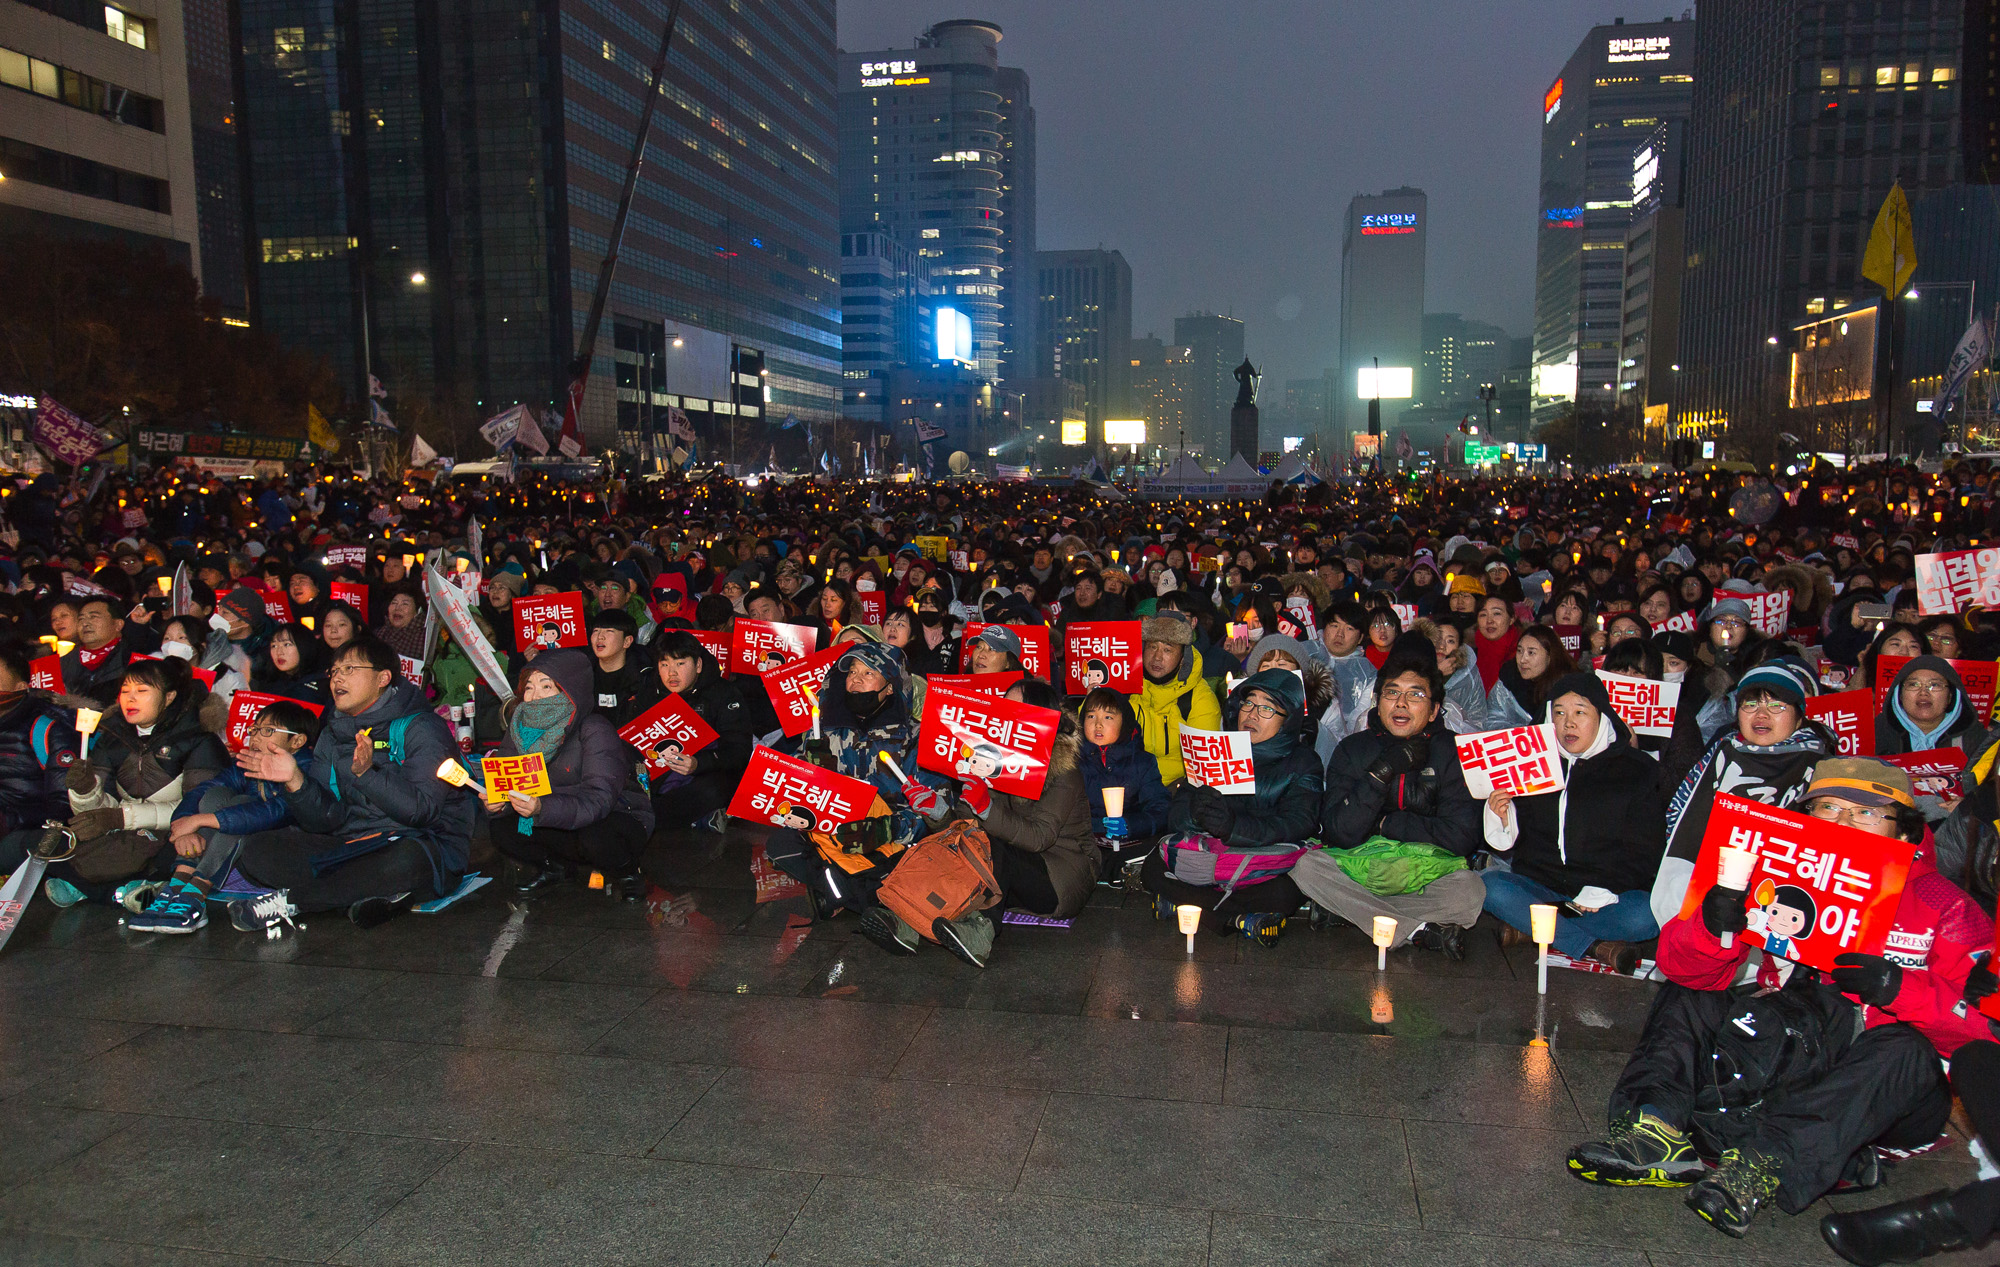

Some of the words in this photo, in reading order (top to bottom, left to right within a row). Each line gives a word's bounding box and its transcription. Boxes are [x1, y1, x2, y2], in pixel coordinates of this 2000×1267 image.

[1609, 37, 1670, 53] 감리교본부
[860, 60, 917, 76] 동아일보
[1608, 54, 1644, 63] Methodist
[1645, 52, 1670, 61] Center
[1360, 213, 1417, 227] 조선일보
[138, 431, 184, 452] 박근혜
[522, 604, 574, 622] 박근혜는
[523, 625, 535, 640] 하
[561, 620, 576, 636] 야
[744, 630, 805, 655] 박근혜는
[1070, 636, 1130, 658] 박근혜는
[743, 650, 758, 665] 하
[1023, 657, 1039, 674] 야
[1071, 661, 1082, 681] 하
[1111, 660, 1130, 681] 야
[789, 698, 810, 717] 하
[232, 722, 246, 740] 하
[676, 725, 699, 742] 야
[939, 704, 1038, 752] 박근혜는
[934, 734, 957, 762] 하
[1179, 732, 1234, 762] 박근혜
[1457, 725, 1549, 771] 박근혜
[1837, 733, 1860, 755] 야
[483, 755, 544, 777] 박근혜
[1489, 756, 1556, 796] 퇴진
[493, 773, 541, 793] 퇴진
[762, 767, 852, 820] 박근혜는
[751, 792, 776, 815] 하
[1749, 809, 1804, 830] www.nanum.com
[1728, 826, 1872, 902] 박근혜는
[1819, 904, 1861, 948] 야
